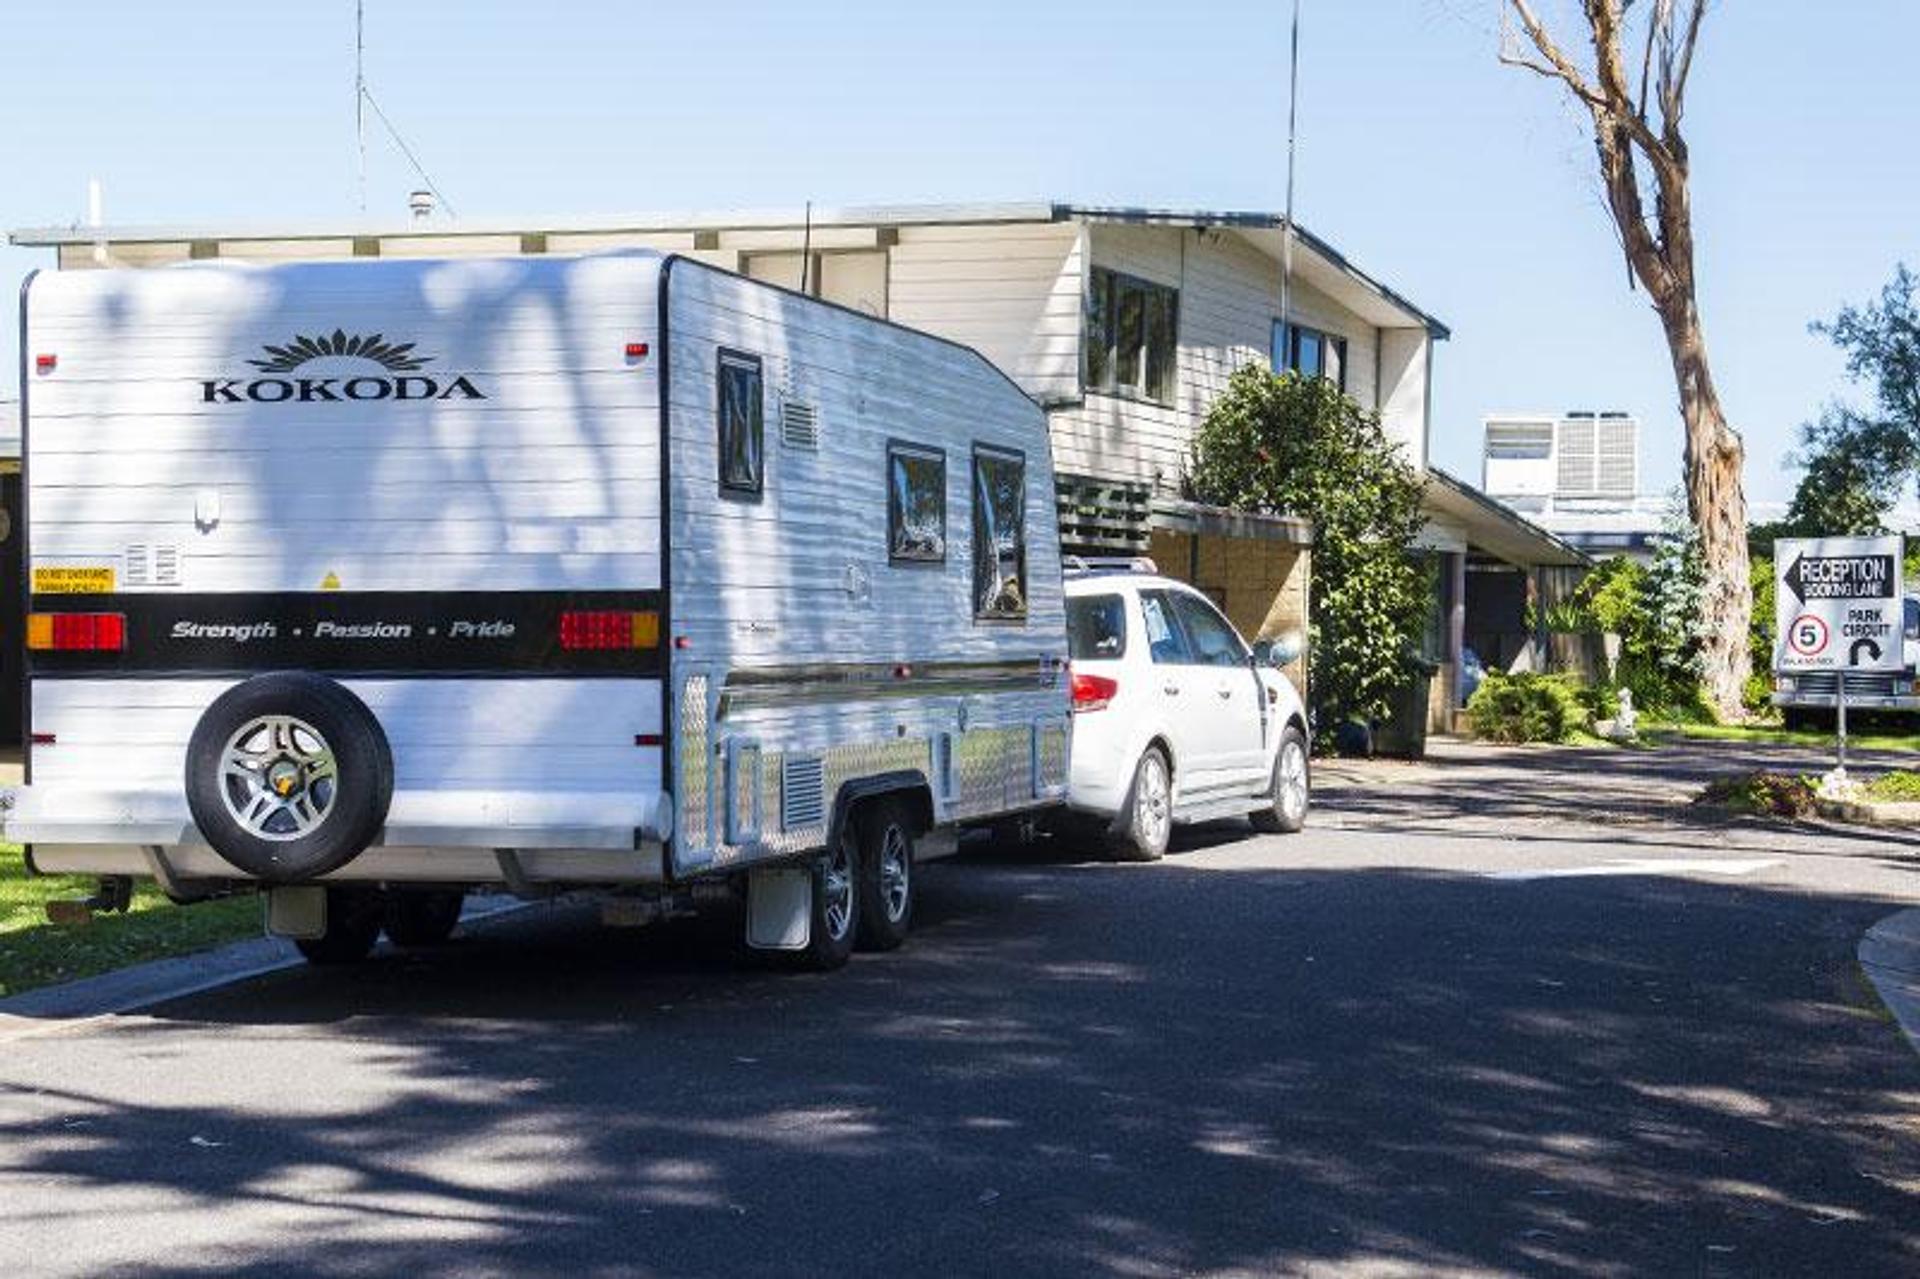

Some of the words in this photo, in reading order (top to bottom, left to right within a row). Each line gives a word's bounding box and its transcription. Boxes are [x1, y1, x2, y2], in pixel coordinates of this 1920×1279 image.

[202, 376, 487, 402] KOKODA
[1800, 558, 1885, 582] RECEPTION
[1804, 583, 1851, 596] BOOKING
[1854, 582, 1882, 596] LANE
[1848, 609, 1882, 622] PARK
[171, 621, 277, 641] Strength
[314, 621, 412, 638] Passion
[450, 620, 516, 638] Pride
[1800, 625, 1816, 646] 5
[1842, 624, 1891, 637] CIRCUIT
